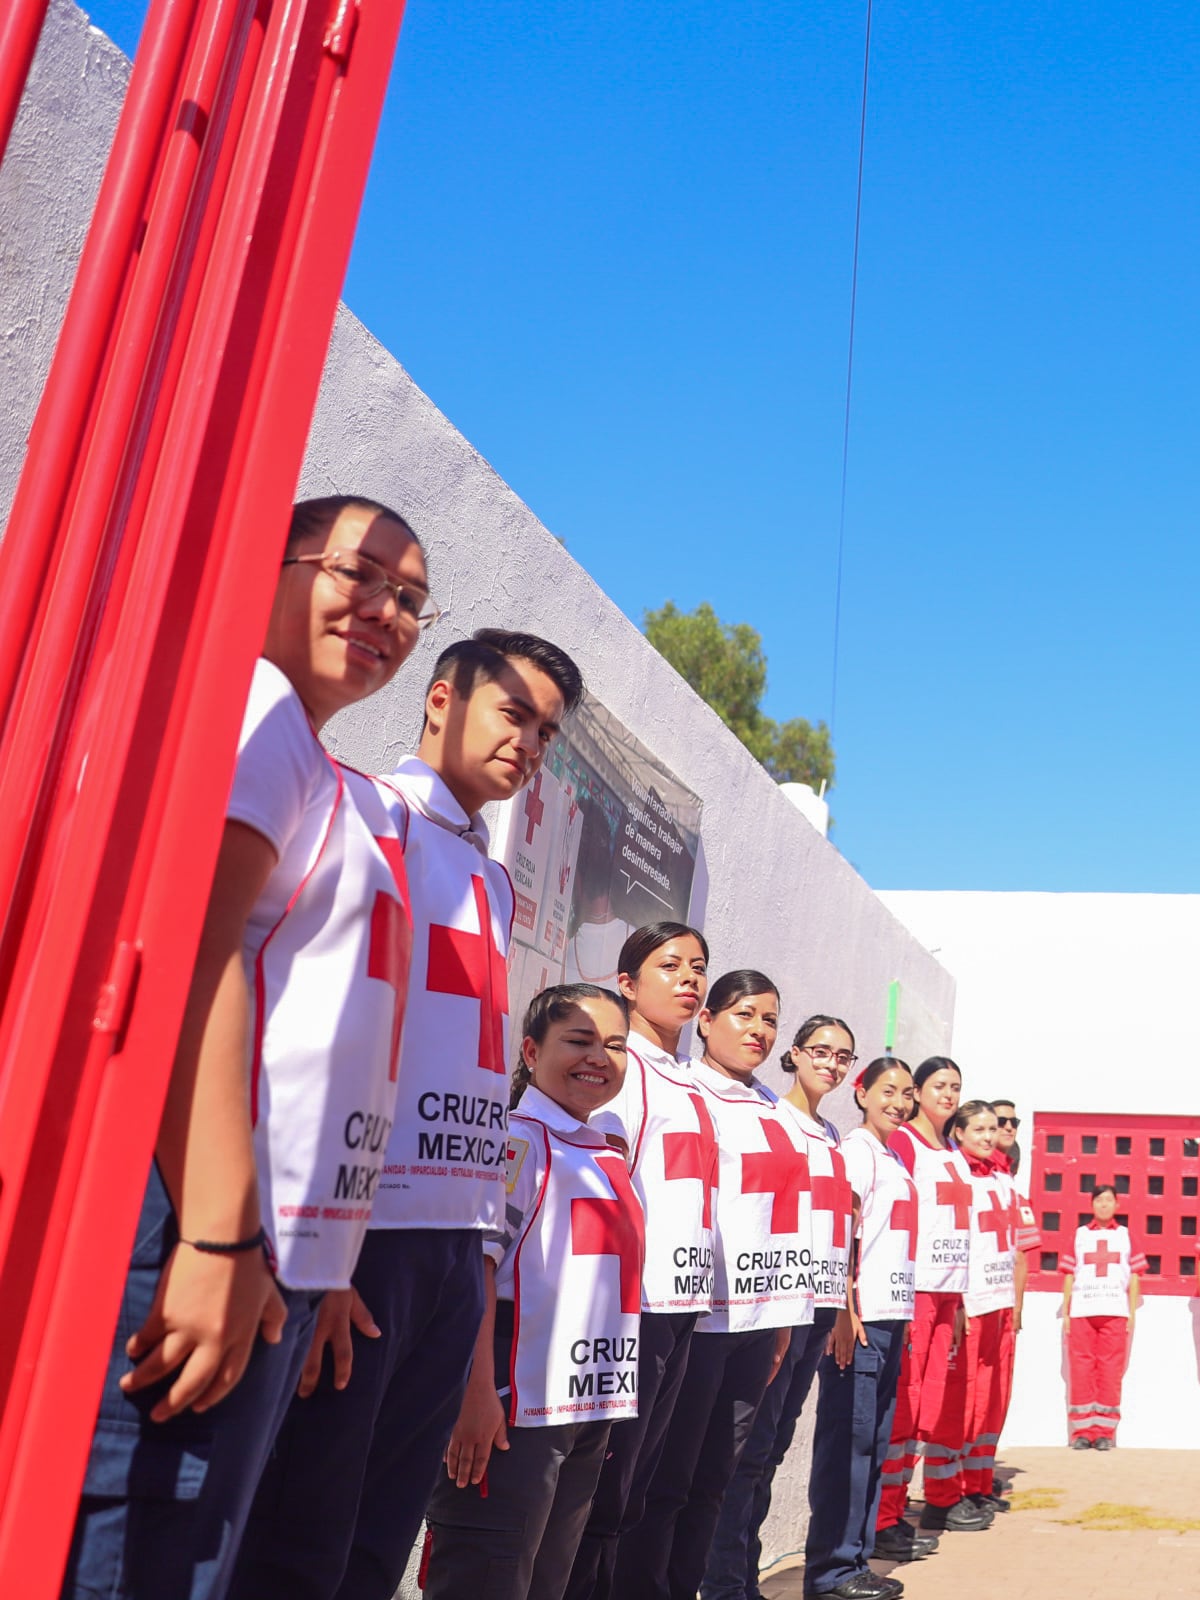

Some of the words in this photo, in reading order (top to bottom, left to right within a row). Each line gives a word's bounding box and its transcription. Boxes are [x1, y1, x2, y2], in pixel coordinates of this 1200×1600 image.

[631, 777, 673, 825] Voluntariado
[625, 822, 635, 839] de
[635, 832, 662, 861] manera
[627, 801, 657, 834] significa
[658, 825, 684, 855] trabajar
[622, 844, 671, 891] desinteresada.
[418, 1091, 488, 1127] CRUZ
[736, 1250, 782, 1271] CRUZ
[570, 1337, 637, 1365] CRUZ
[568, 1371, 636, 1398] MEXI
